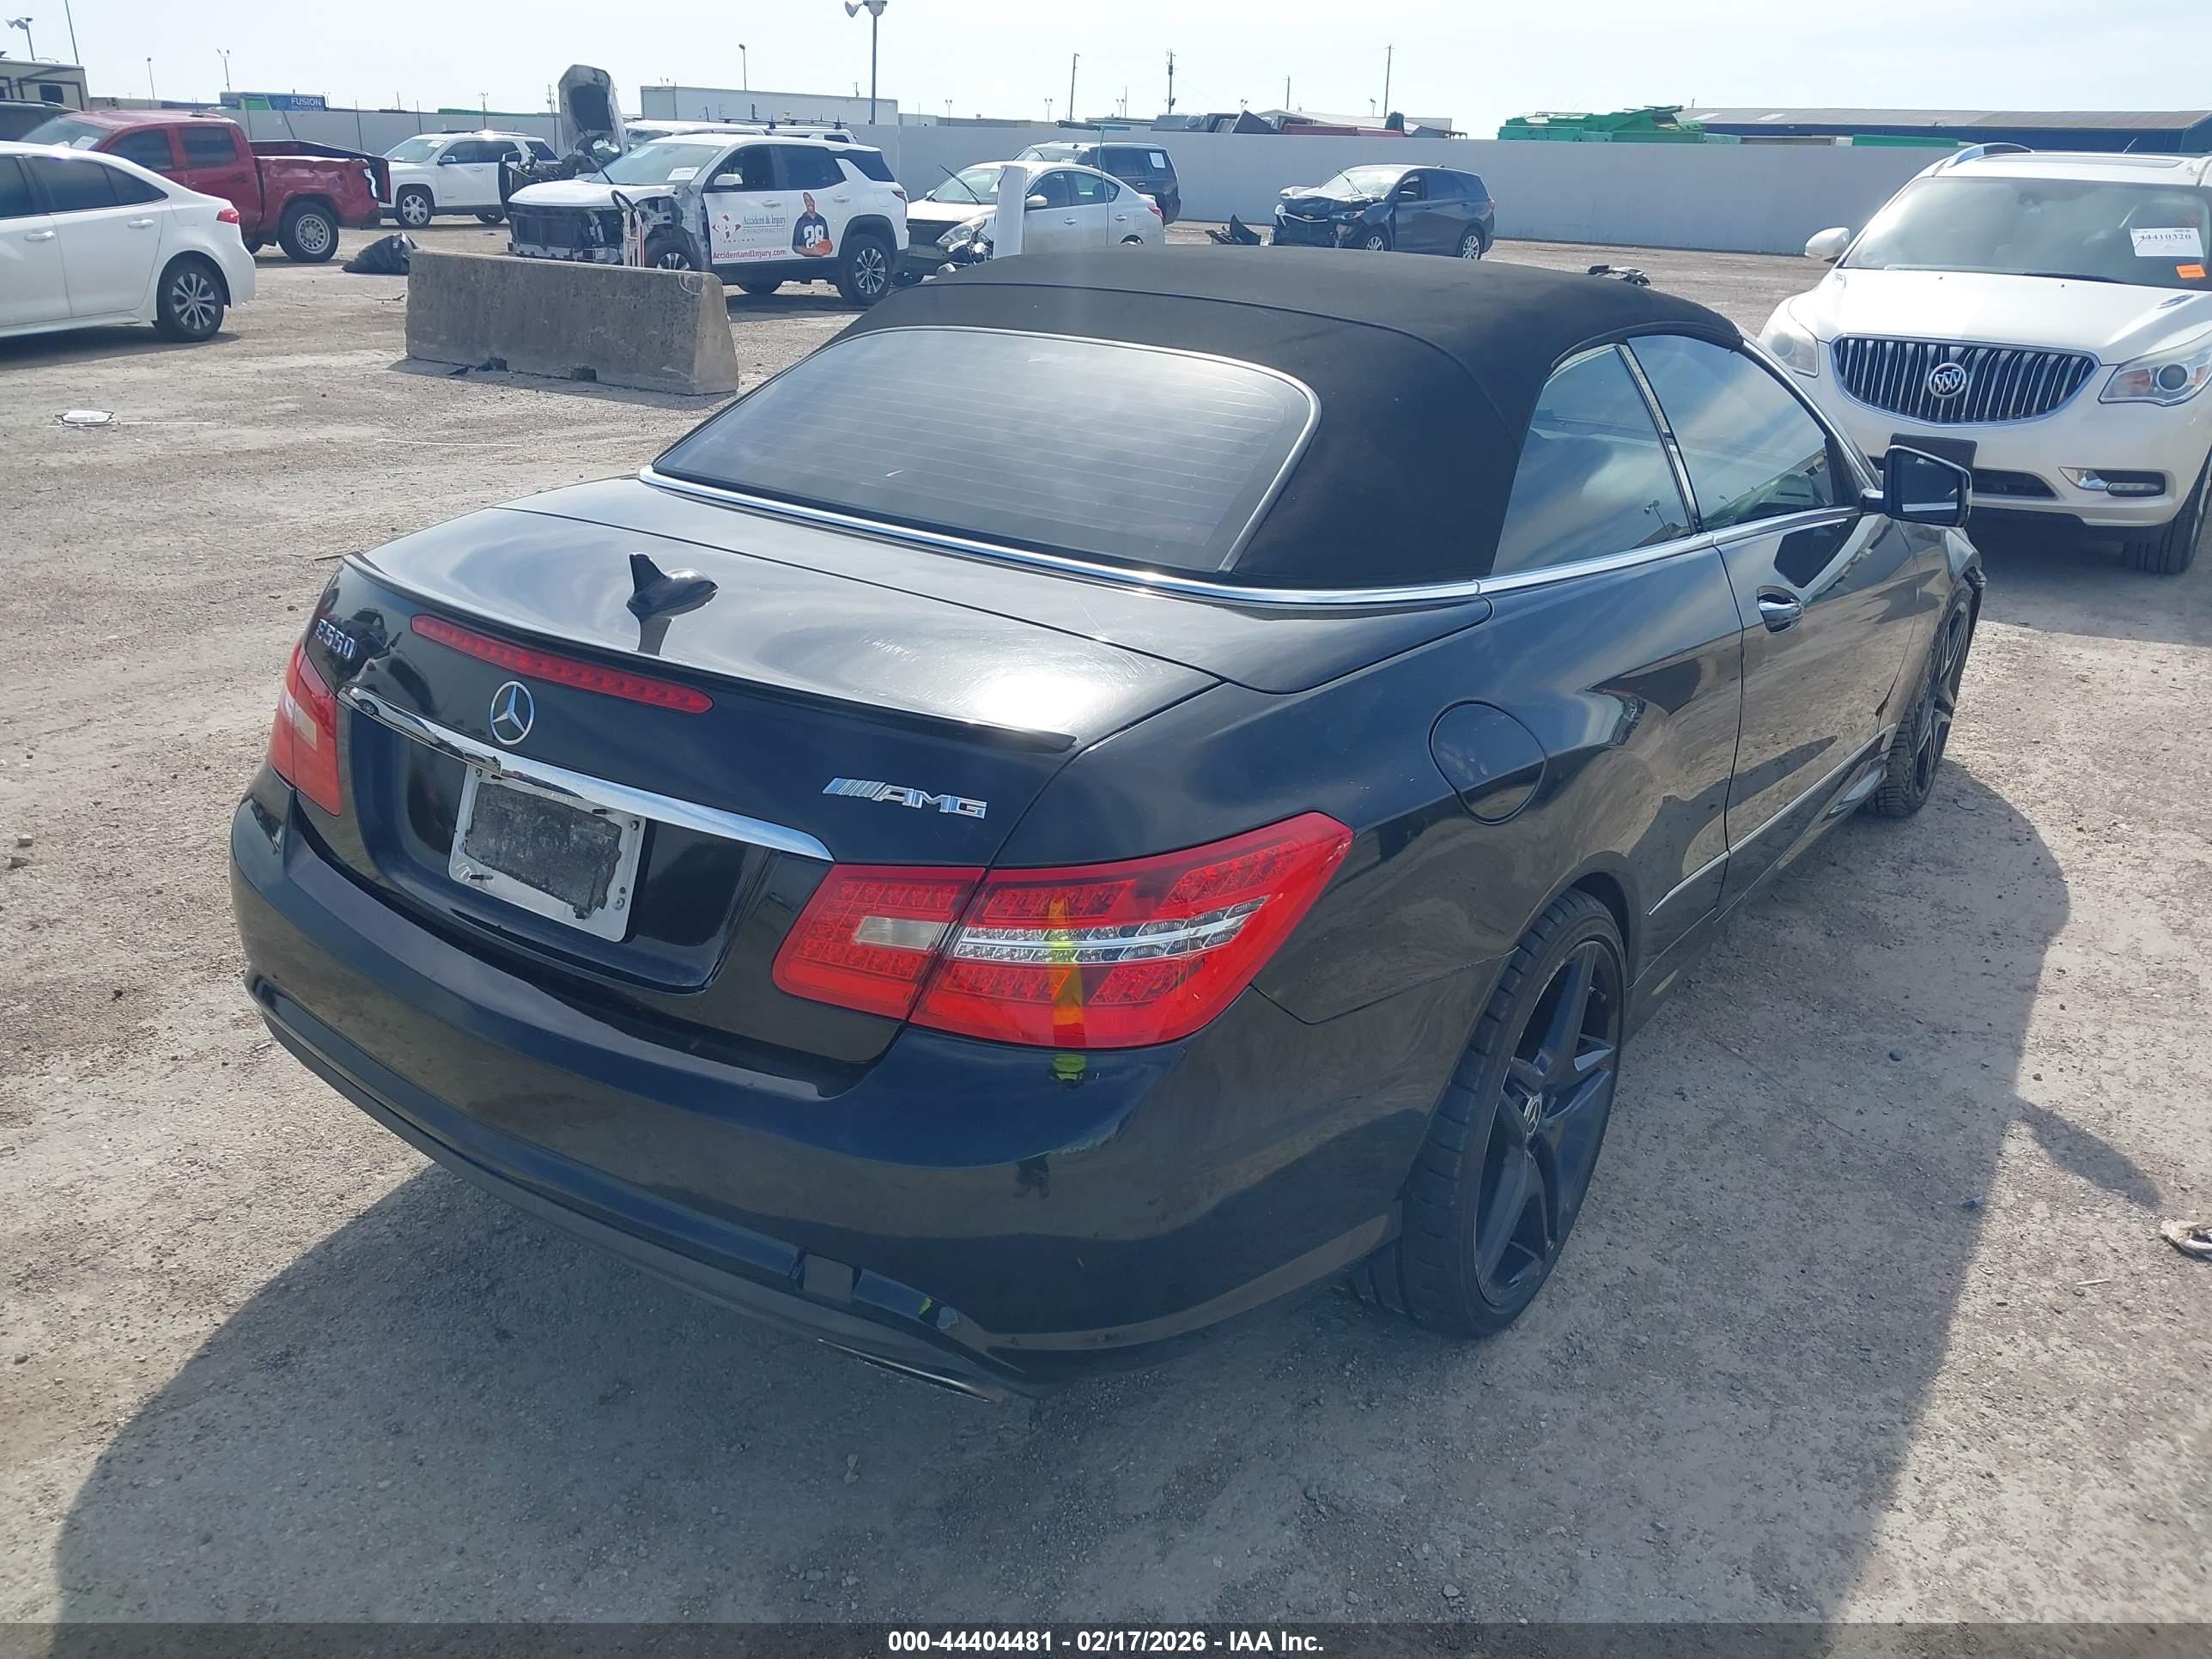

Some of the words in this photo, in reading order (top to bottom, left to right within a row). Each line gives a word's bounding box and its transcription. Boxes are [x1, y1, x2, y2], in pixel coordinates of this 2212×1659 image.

[291, 97, 321, 106] FUSION
[743, 216, 764, 225] Accident
[765, 216, 770, 224] &
[771, 215, 786, 227] Injury
[713, 248, 787, 260] AccidentandInjury.com
